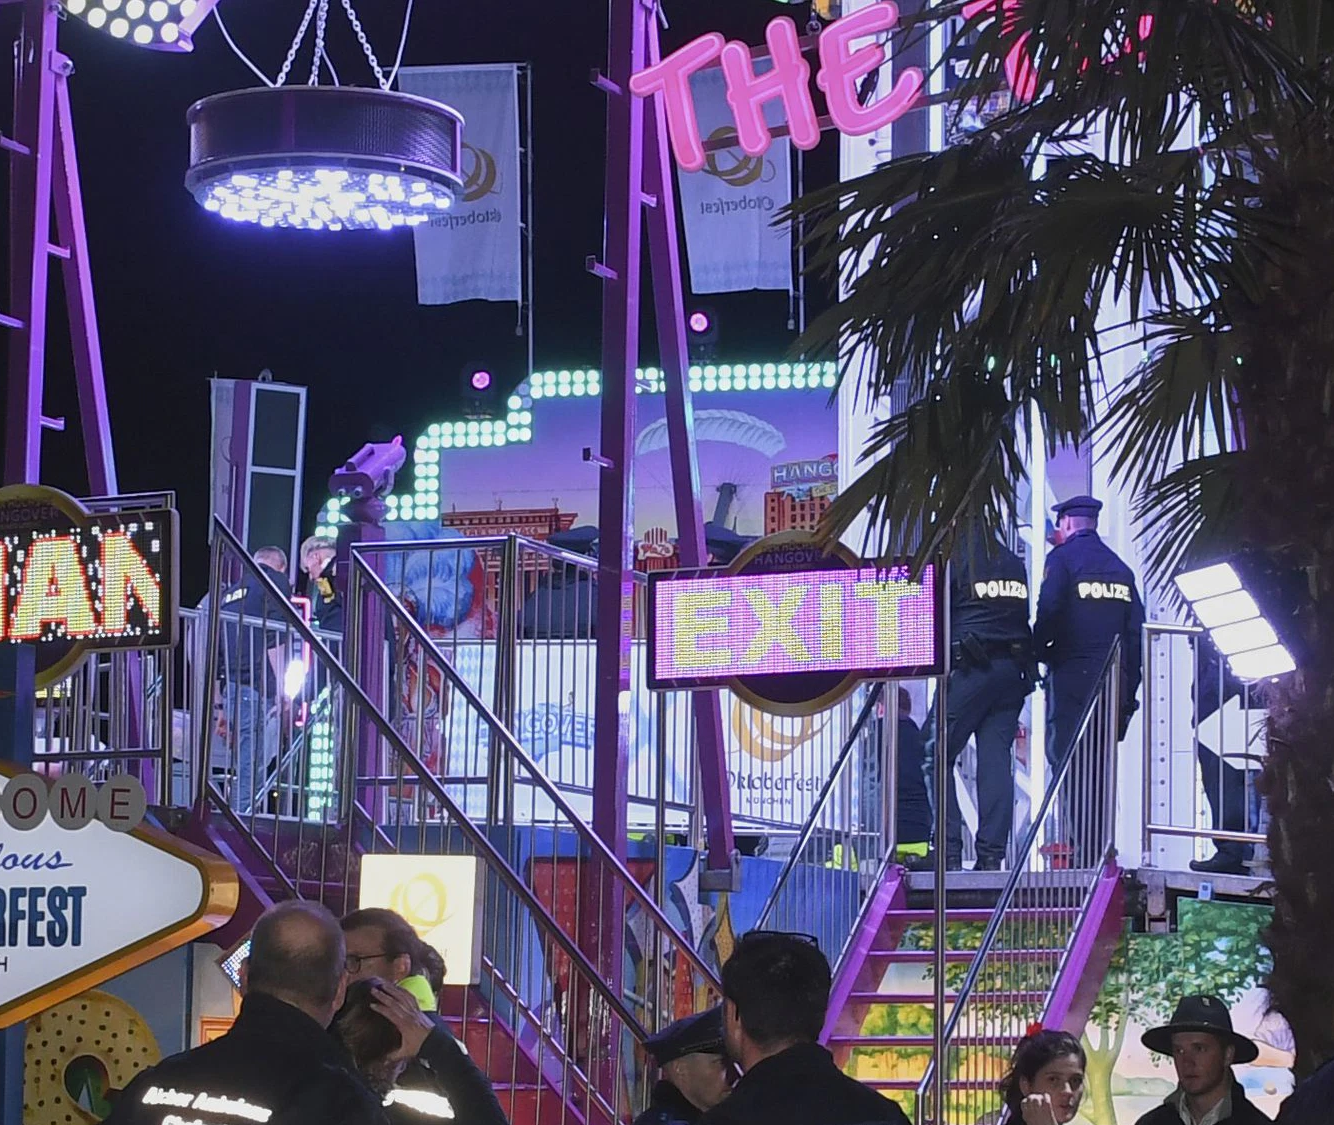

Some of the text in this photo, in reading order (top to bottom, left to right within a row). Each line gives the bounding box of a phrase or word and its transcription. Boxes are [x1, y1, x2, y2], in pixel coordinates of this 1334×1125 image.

[630, 1, 923, 173] THE
[755, 549, 829, 565] HANGOV
[674, 581, 923, 667] EXIT
